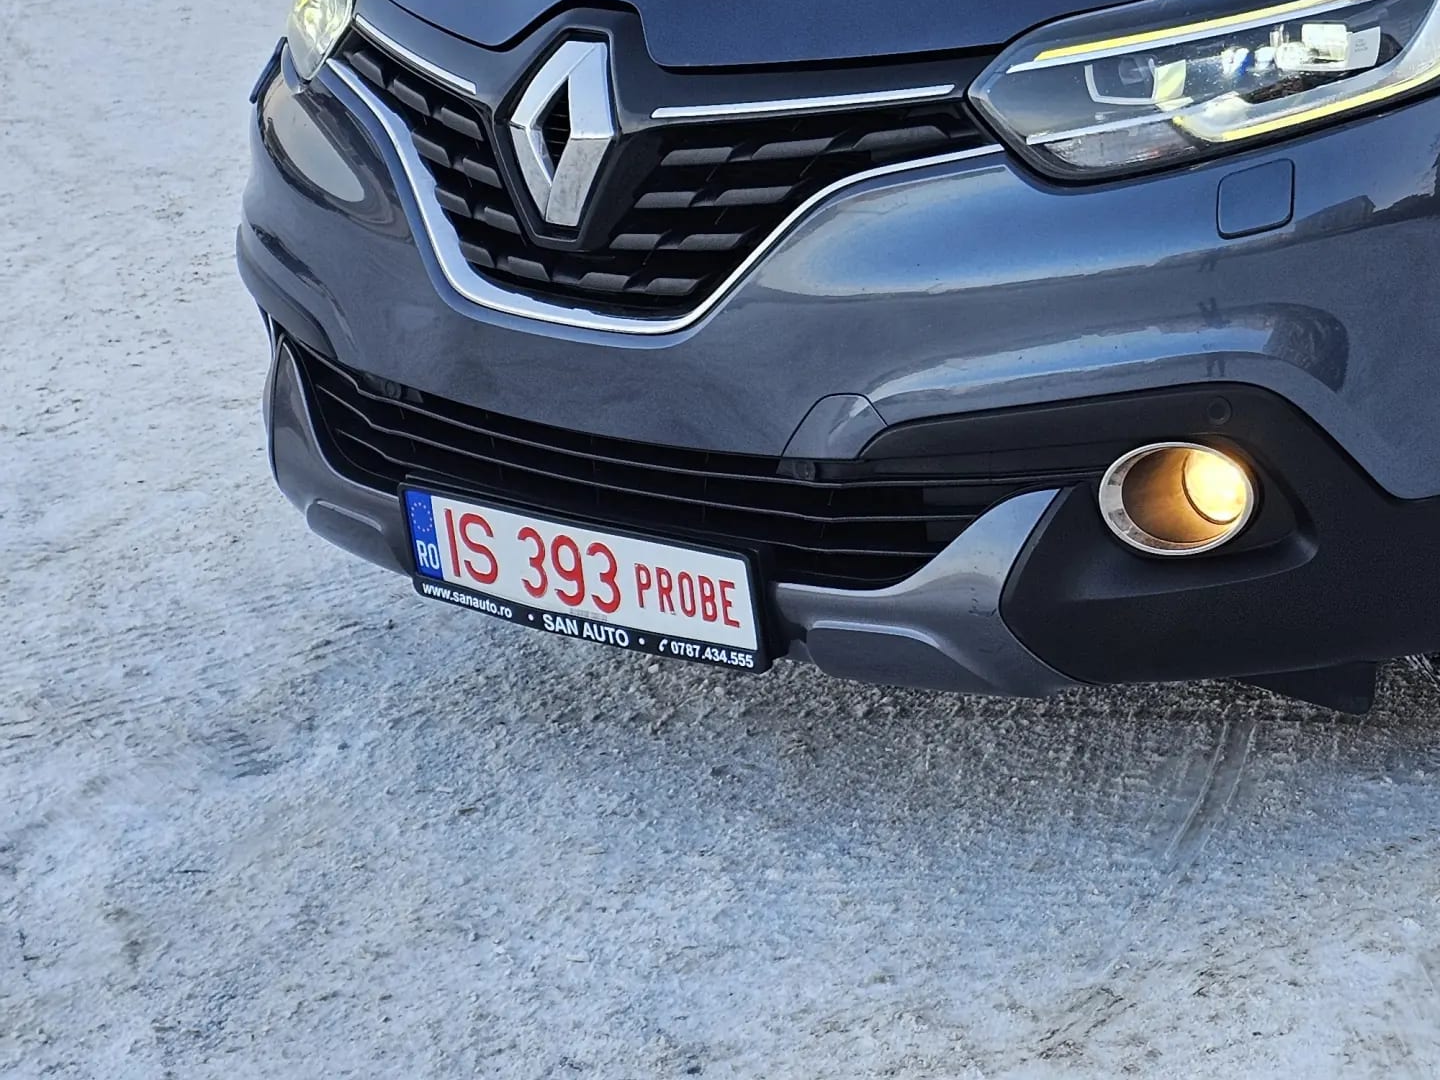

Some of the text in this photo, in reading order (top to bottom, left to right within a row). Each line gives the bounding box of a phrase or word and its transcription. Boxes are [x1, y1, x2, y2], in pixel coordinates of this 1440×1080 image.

[416, 540, 440, 570] RO
[444, 508, 741, 628] IS 393 PROBE
[422, 582, 513, 619] www.sanauto.ro
[542, 613, 579, 636] SAN
[582, 621, 630, 647] AUTO
[670, 641, 755, 669] 0787.434.555
